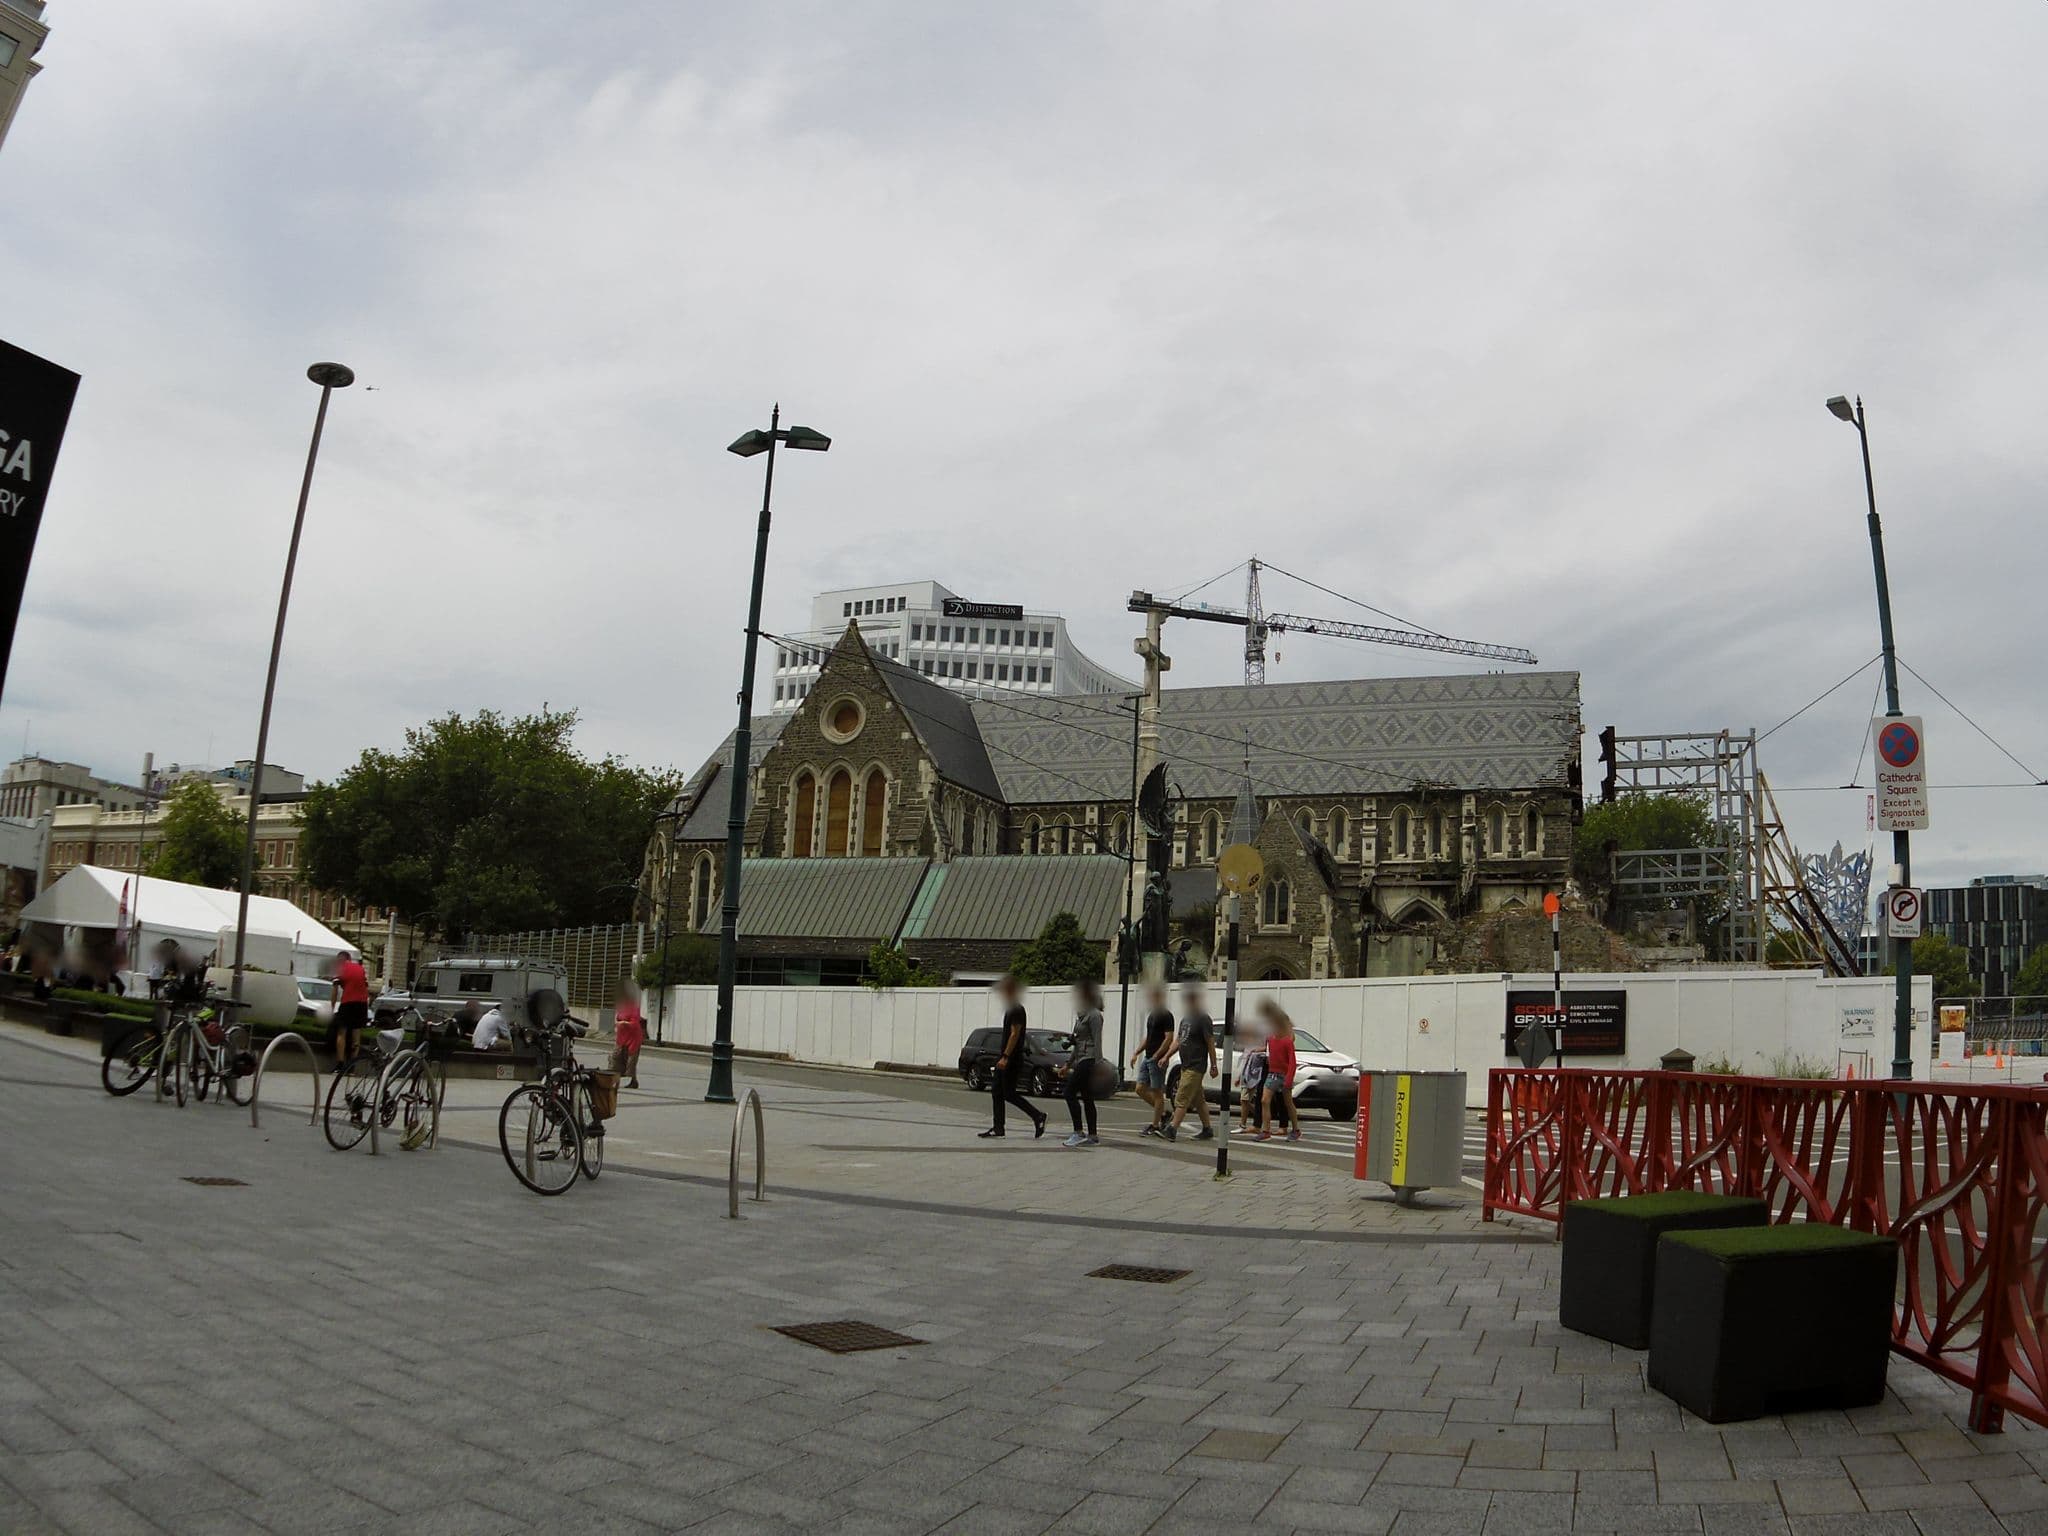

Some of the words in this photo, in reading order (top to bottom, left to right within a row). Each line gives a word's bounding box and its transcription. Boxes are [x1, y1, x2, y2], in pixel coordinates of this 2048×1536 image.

[1879, 773, 1922, 783] Cathedral
[1886, 785, 1918, 795] Square
[1883, 799, 1911, 807] Except
[1880, 808, 1925, 819] Signposted
[1892, 820, 1915, 828] Areas
[1357, 1105, 1366, 1147] Litter
[1392, 1091, 1405, 1167] Recycling
